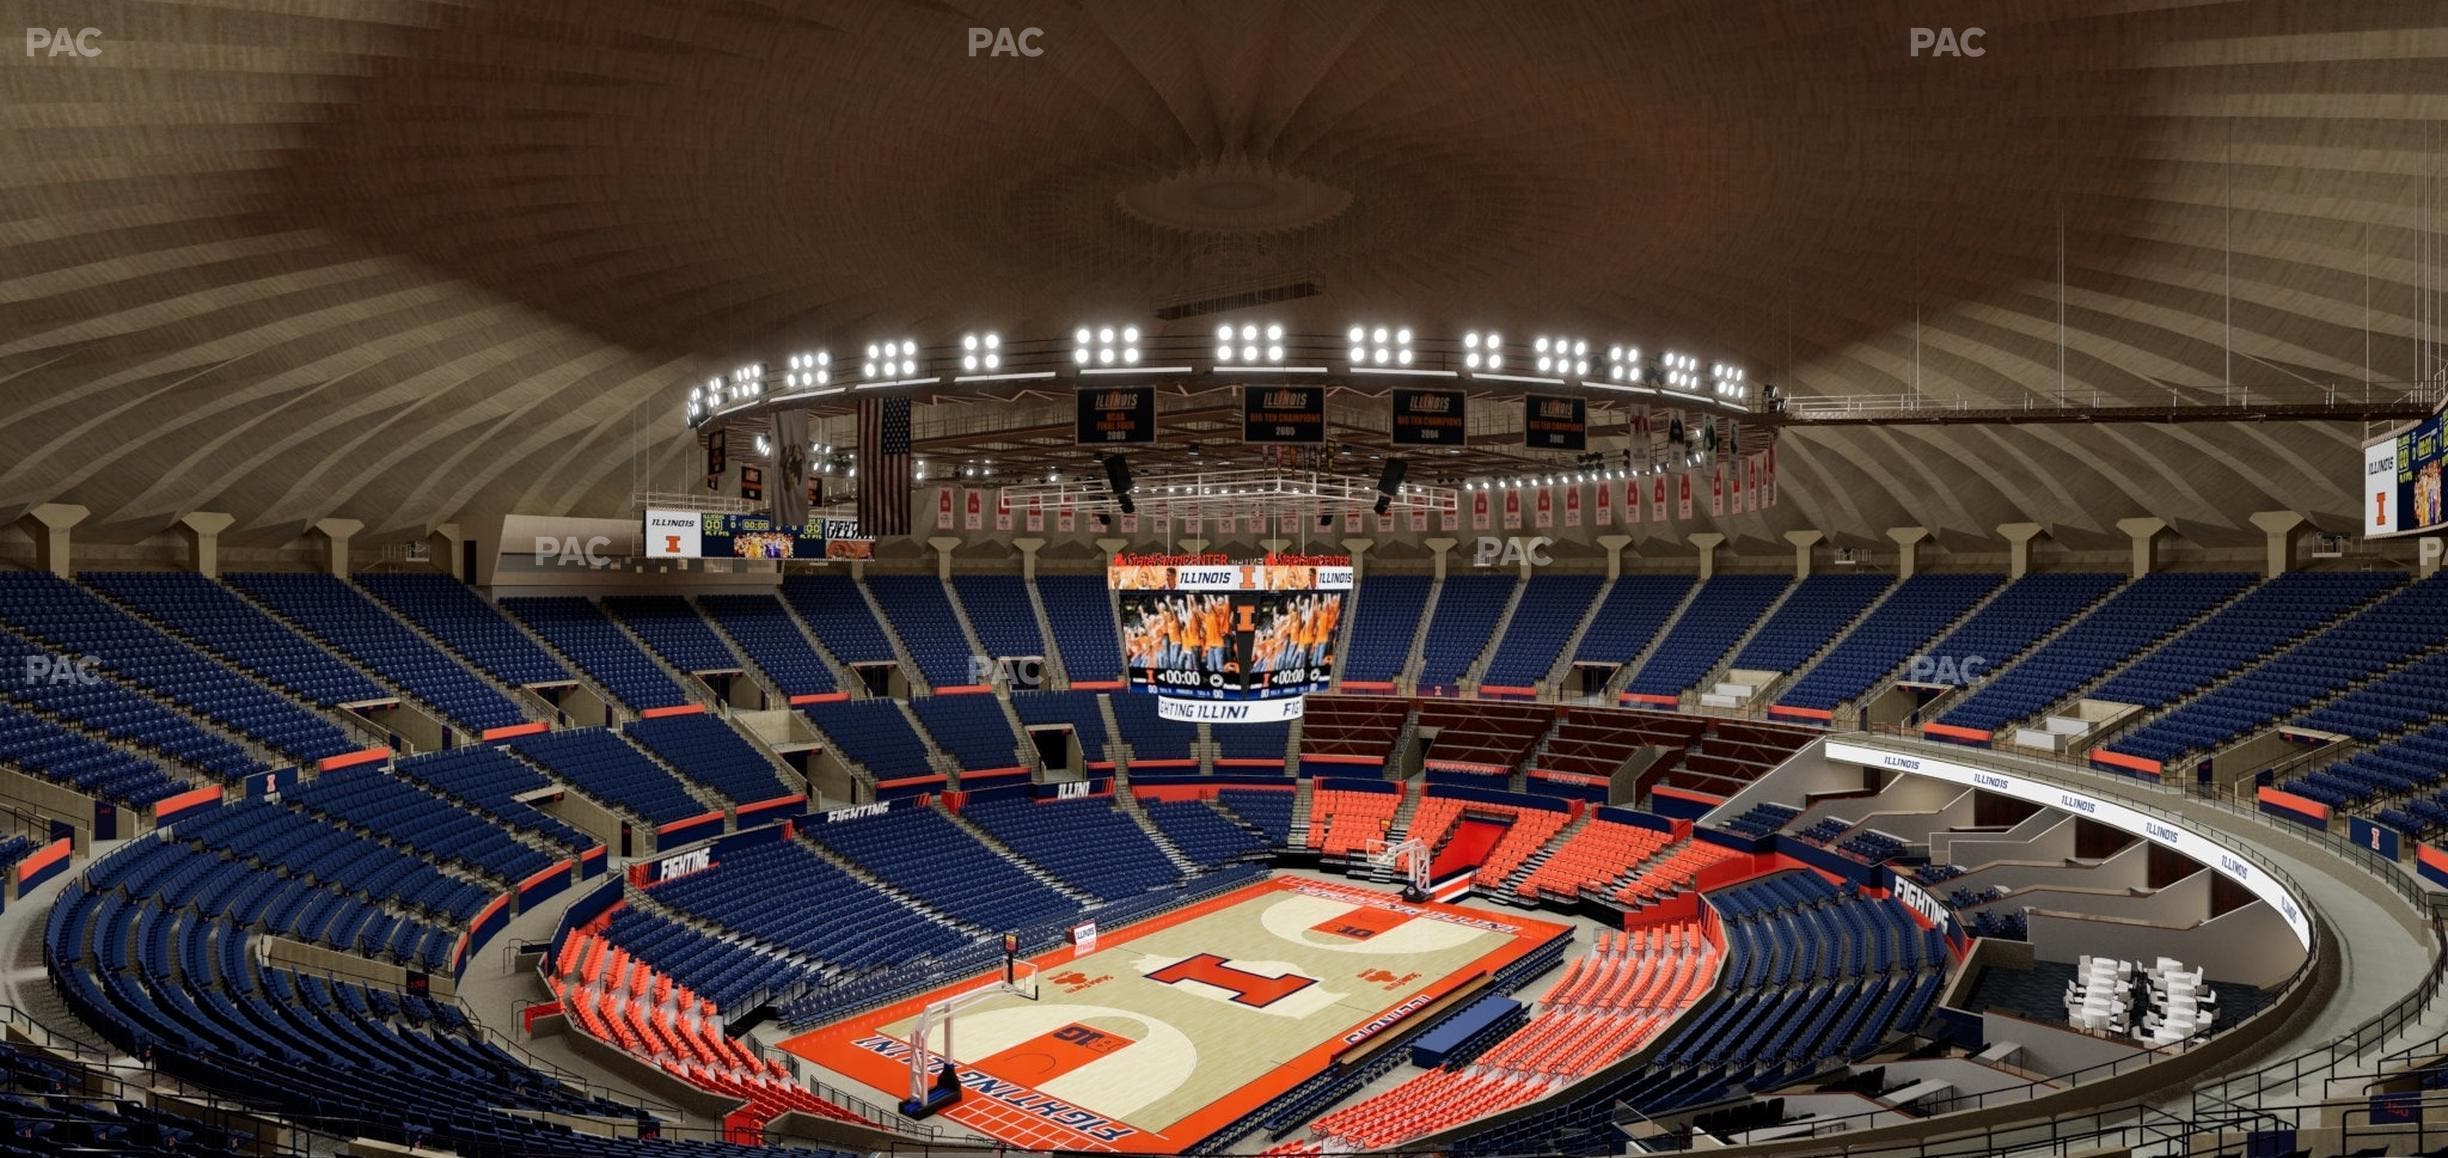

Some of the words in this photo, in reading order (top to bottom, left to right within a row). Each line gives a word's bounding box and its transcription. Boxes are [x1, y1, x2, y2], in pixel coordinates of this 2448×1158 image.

[1095, 394, 1138, 408] ILLINOIS
[1263, 392, 1308, 406] ILLINOIS
[1410, 395, 1450, 410] ILLINOIS
[651, 518, 695, 528] ILLINOIS
[1179, 572, 1231, 584] ILLINOIS
[1318, 572, 1352, 583] ILLINOIS
[1166, 669, 1200, 686] 00:00
[1278, 668, 1304, 685] 00:00
[1197, 706, 1249, 719] ILLINI
[1884, 756, 1920, 770] ILLINOIS
[1974, 773, 2009, 789] ILLINOIS
[1057, 781, 1090, 800] ILLINI
[828, 801, 890, 823] FIGHTING
[2061, 795, 2096, 813] ILLINOIS
[2146, 822, 2179, 843] ILLINOIS
[661, 847, 710, 881] FIGHTING
[2221, 854, 2248, 880] ILLINOIS
[1894, 875, 1949, 934] FIGHTING
[1343, 994, 1433, 1046] ILLINOIS
[957, 1071, 1139, 1144] FIGHTING
